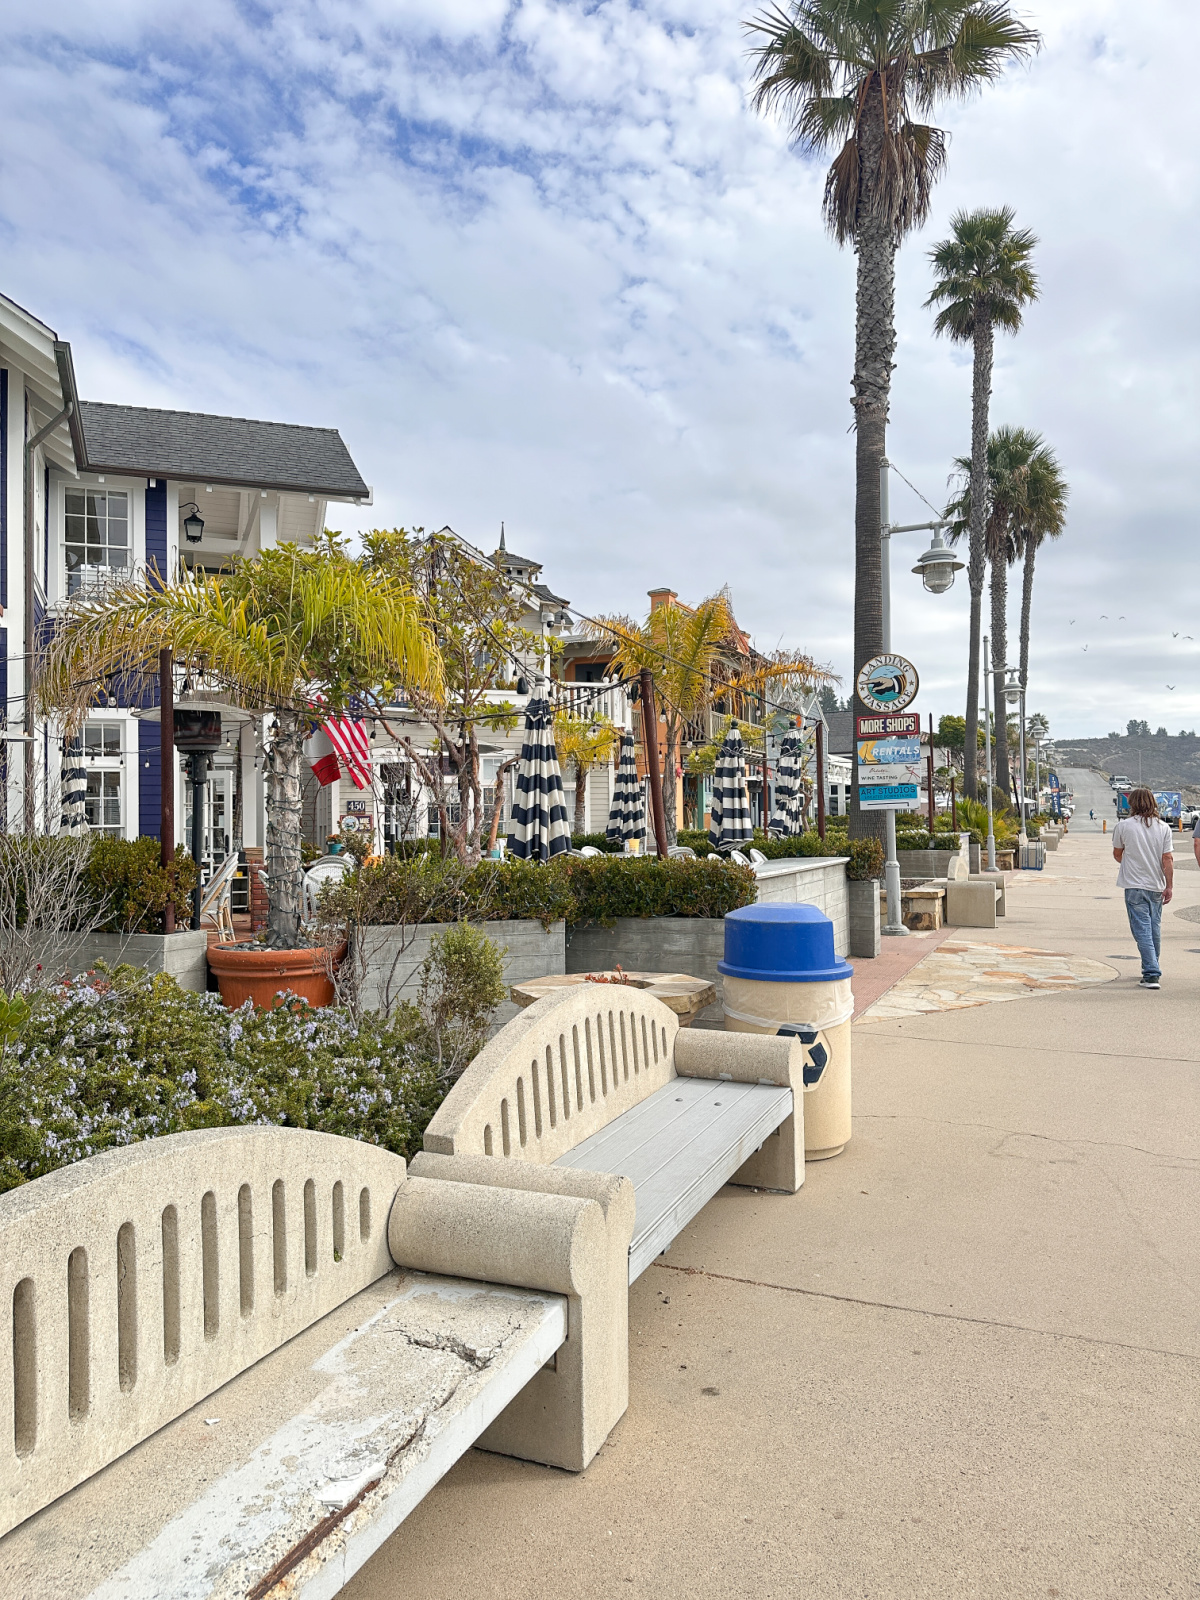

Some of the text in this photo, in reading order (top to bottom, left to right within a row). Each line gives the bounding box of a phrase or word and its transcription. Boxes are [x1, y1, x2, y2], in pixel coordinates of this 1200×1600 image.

[861, 656, 911, 677] LANDING
[863, 690, 913, 711] PASSAGE
[860, 717, 915, 734] MORE SHOPS
[872, 746, 920, 756] RENTALS
[861, 786, 916, 796] ART STUDIOS
[348, 801, 365, 810] 450
